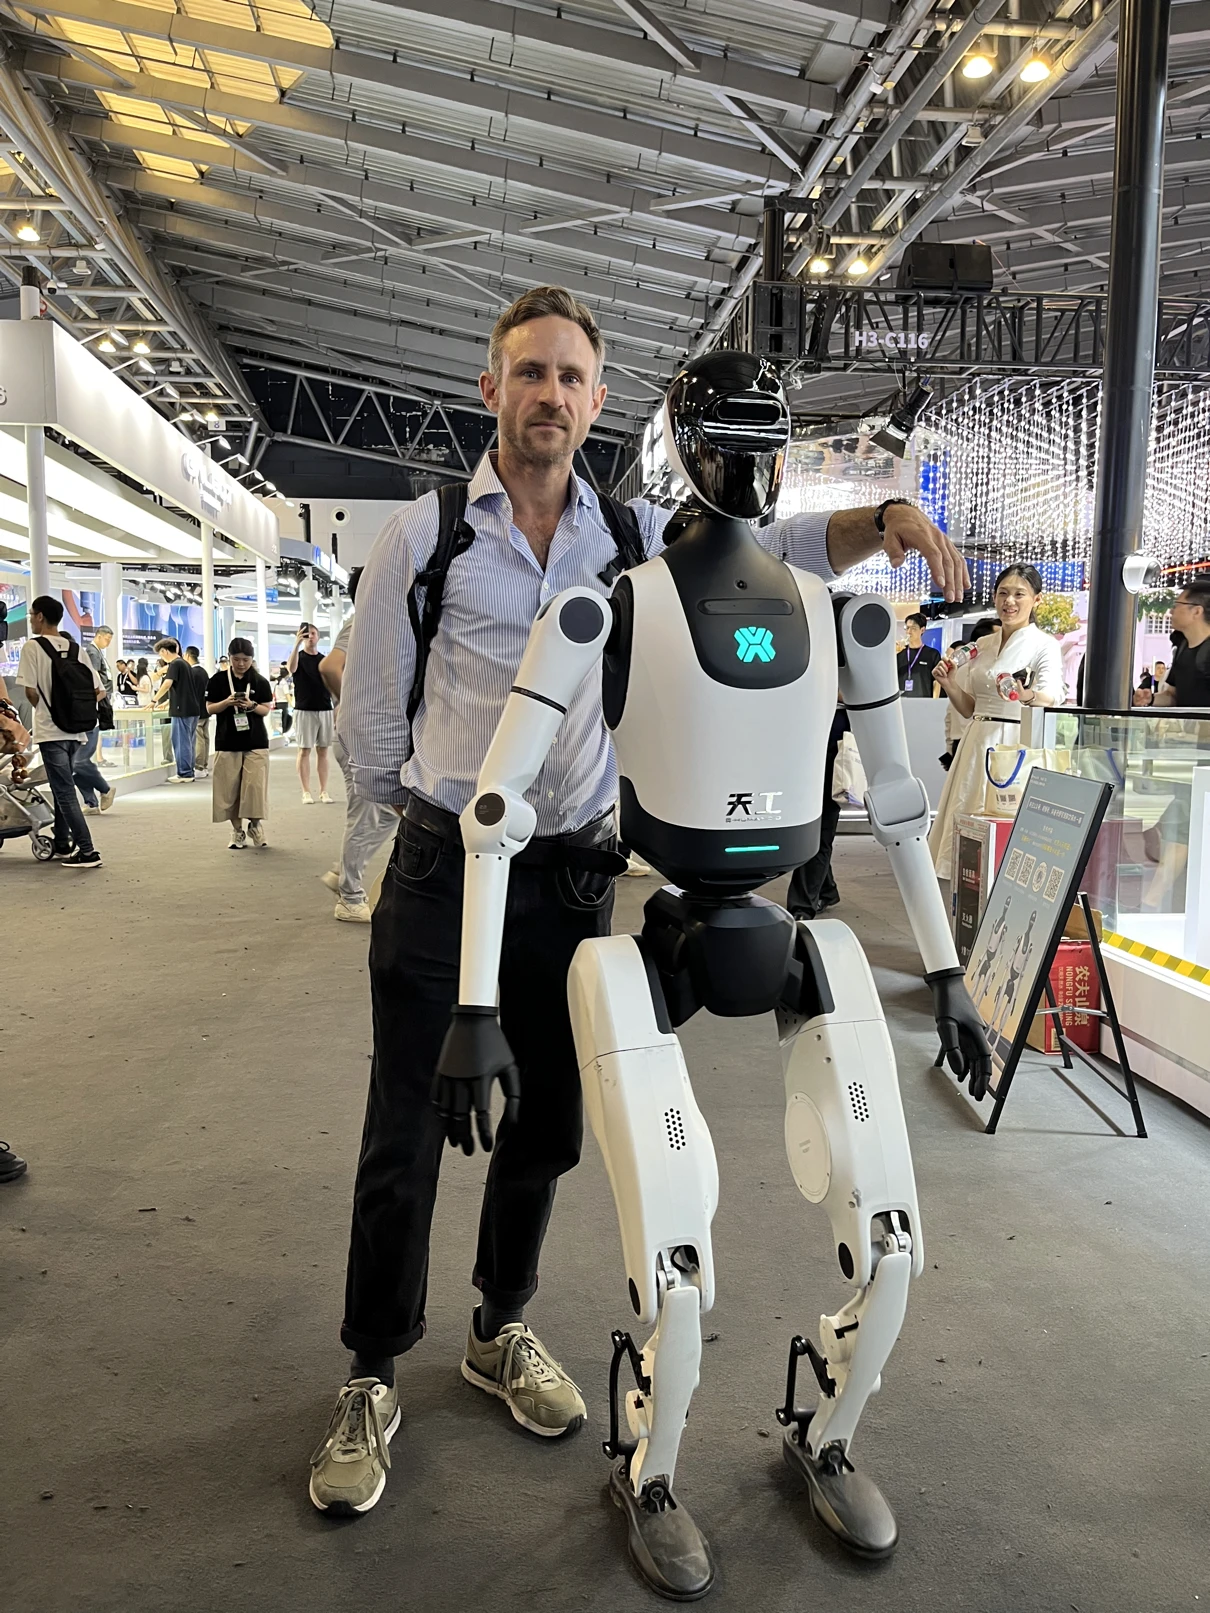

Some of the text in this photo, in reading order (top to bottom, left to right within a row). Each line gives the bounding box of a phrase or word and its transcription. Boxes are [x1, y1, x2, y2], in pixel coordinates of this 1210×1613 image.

[854, 330, 928, 349] H3-C116
[726, 791, 783, 816] 天工
[1075, 965, 1090, 1026] 农夫山泉
